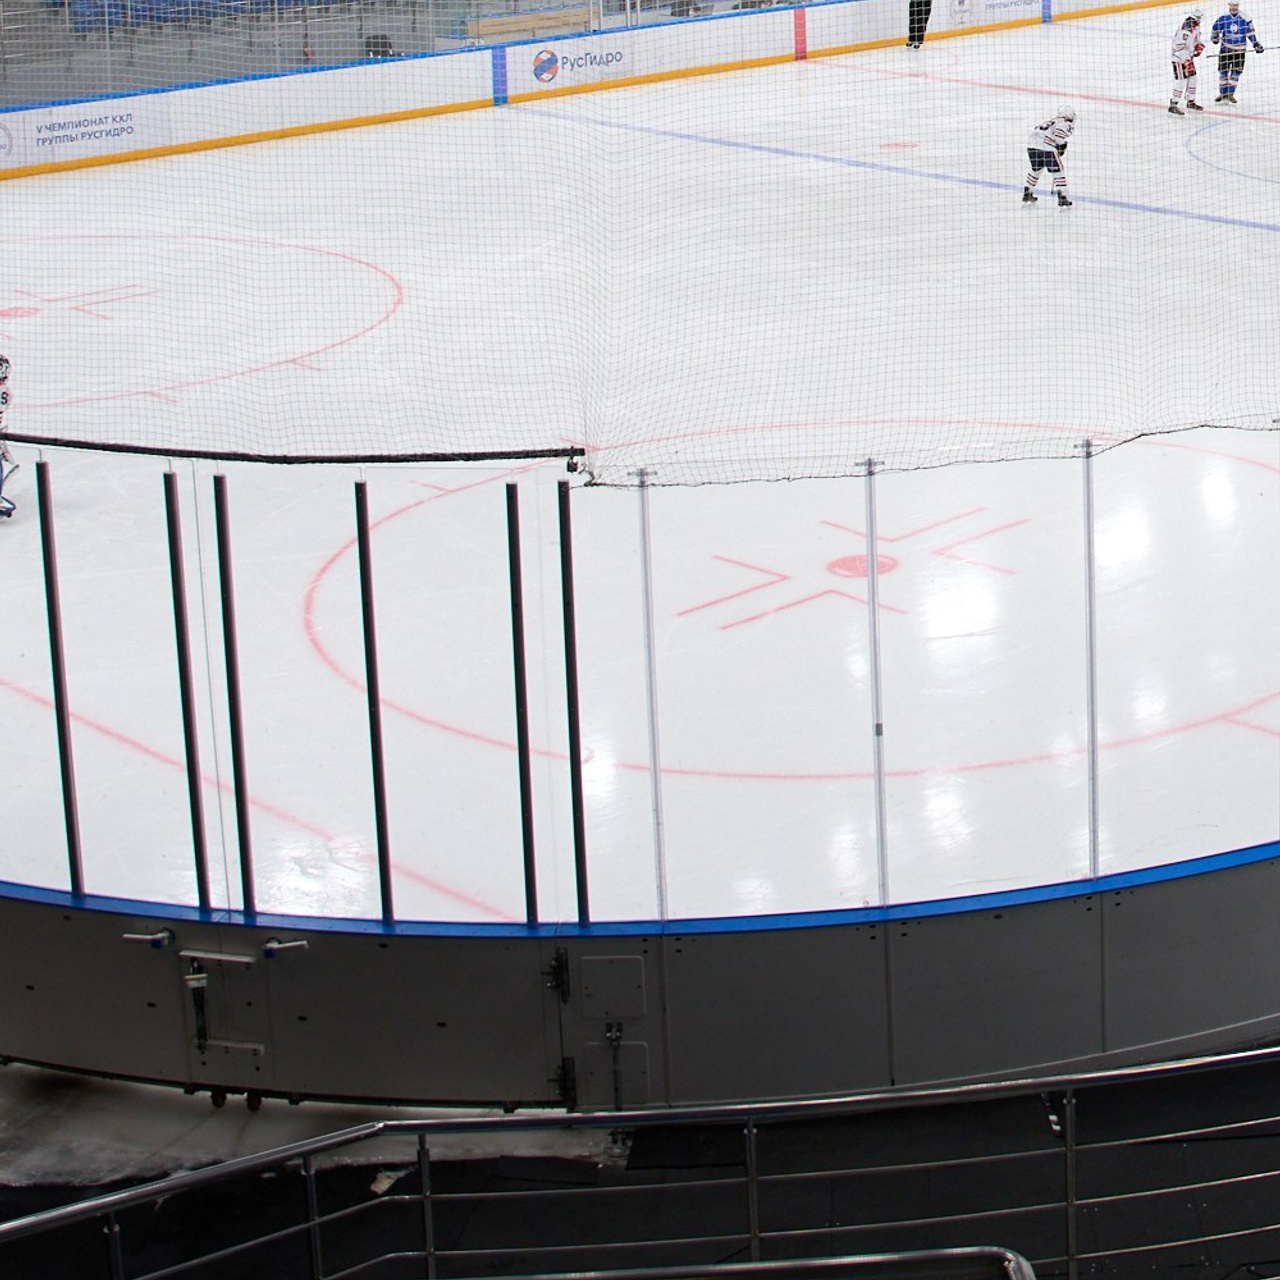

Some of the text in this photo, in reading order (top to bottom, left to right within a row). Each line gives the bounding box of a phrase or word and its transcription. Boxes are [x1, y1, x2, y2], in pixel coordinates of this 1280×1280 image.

[561, 51, 623, 71] РусГидро
[36, 113, 133, 133] V ЧЕМПИОНАТ КХЛ
[36, 126, 134, 147] ГРУППЫ РУСГИДРО
